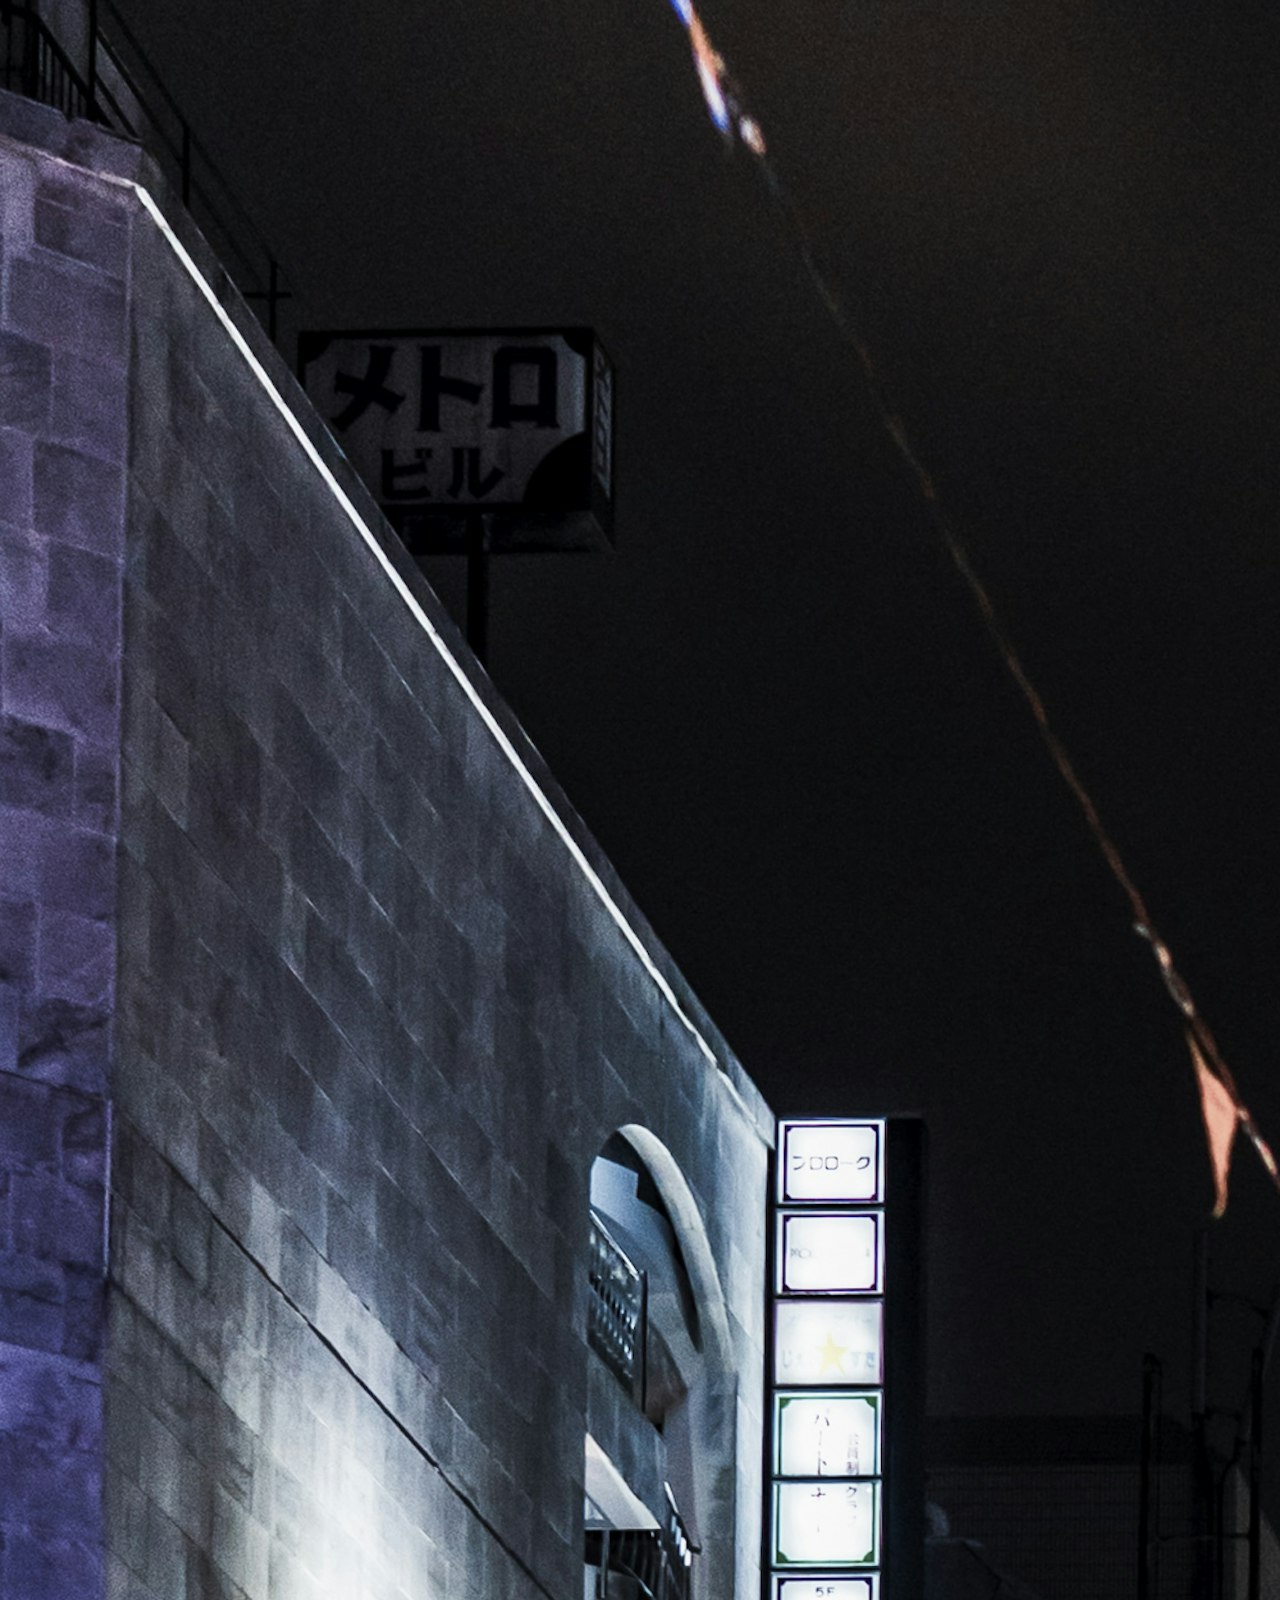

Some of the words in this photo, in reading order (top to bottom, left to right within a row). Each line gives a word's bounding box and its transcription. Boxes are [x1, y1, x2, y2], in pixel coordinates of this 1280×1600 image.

[331, 345, 559, 431] メトロ
[382, 448, 504, 499] ビル
